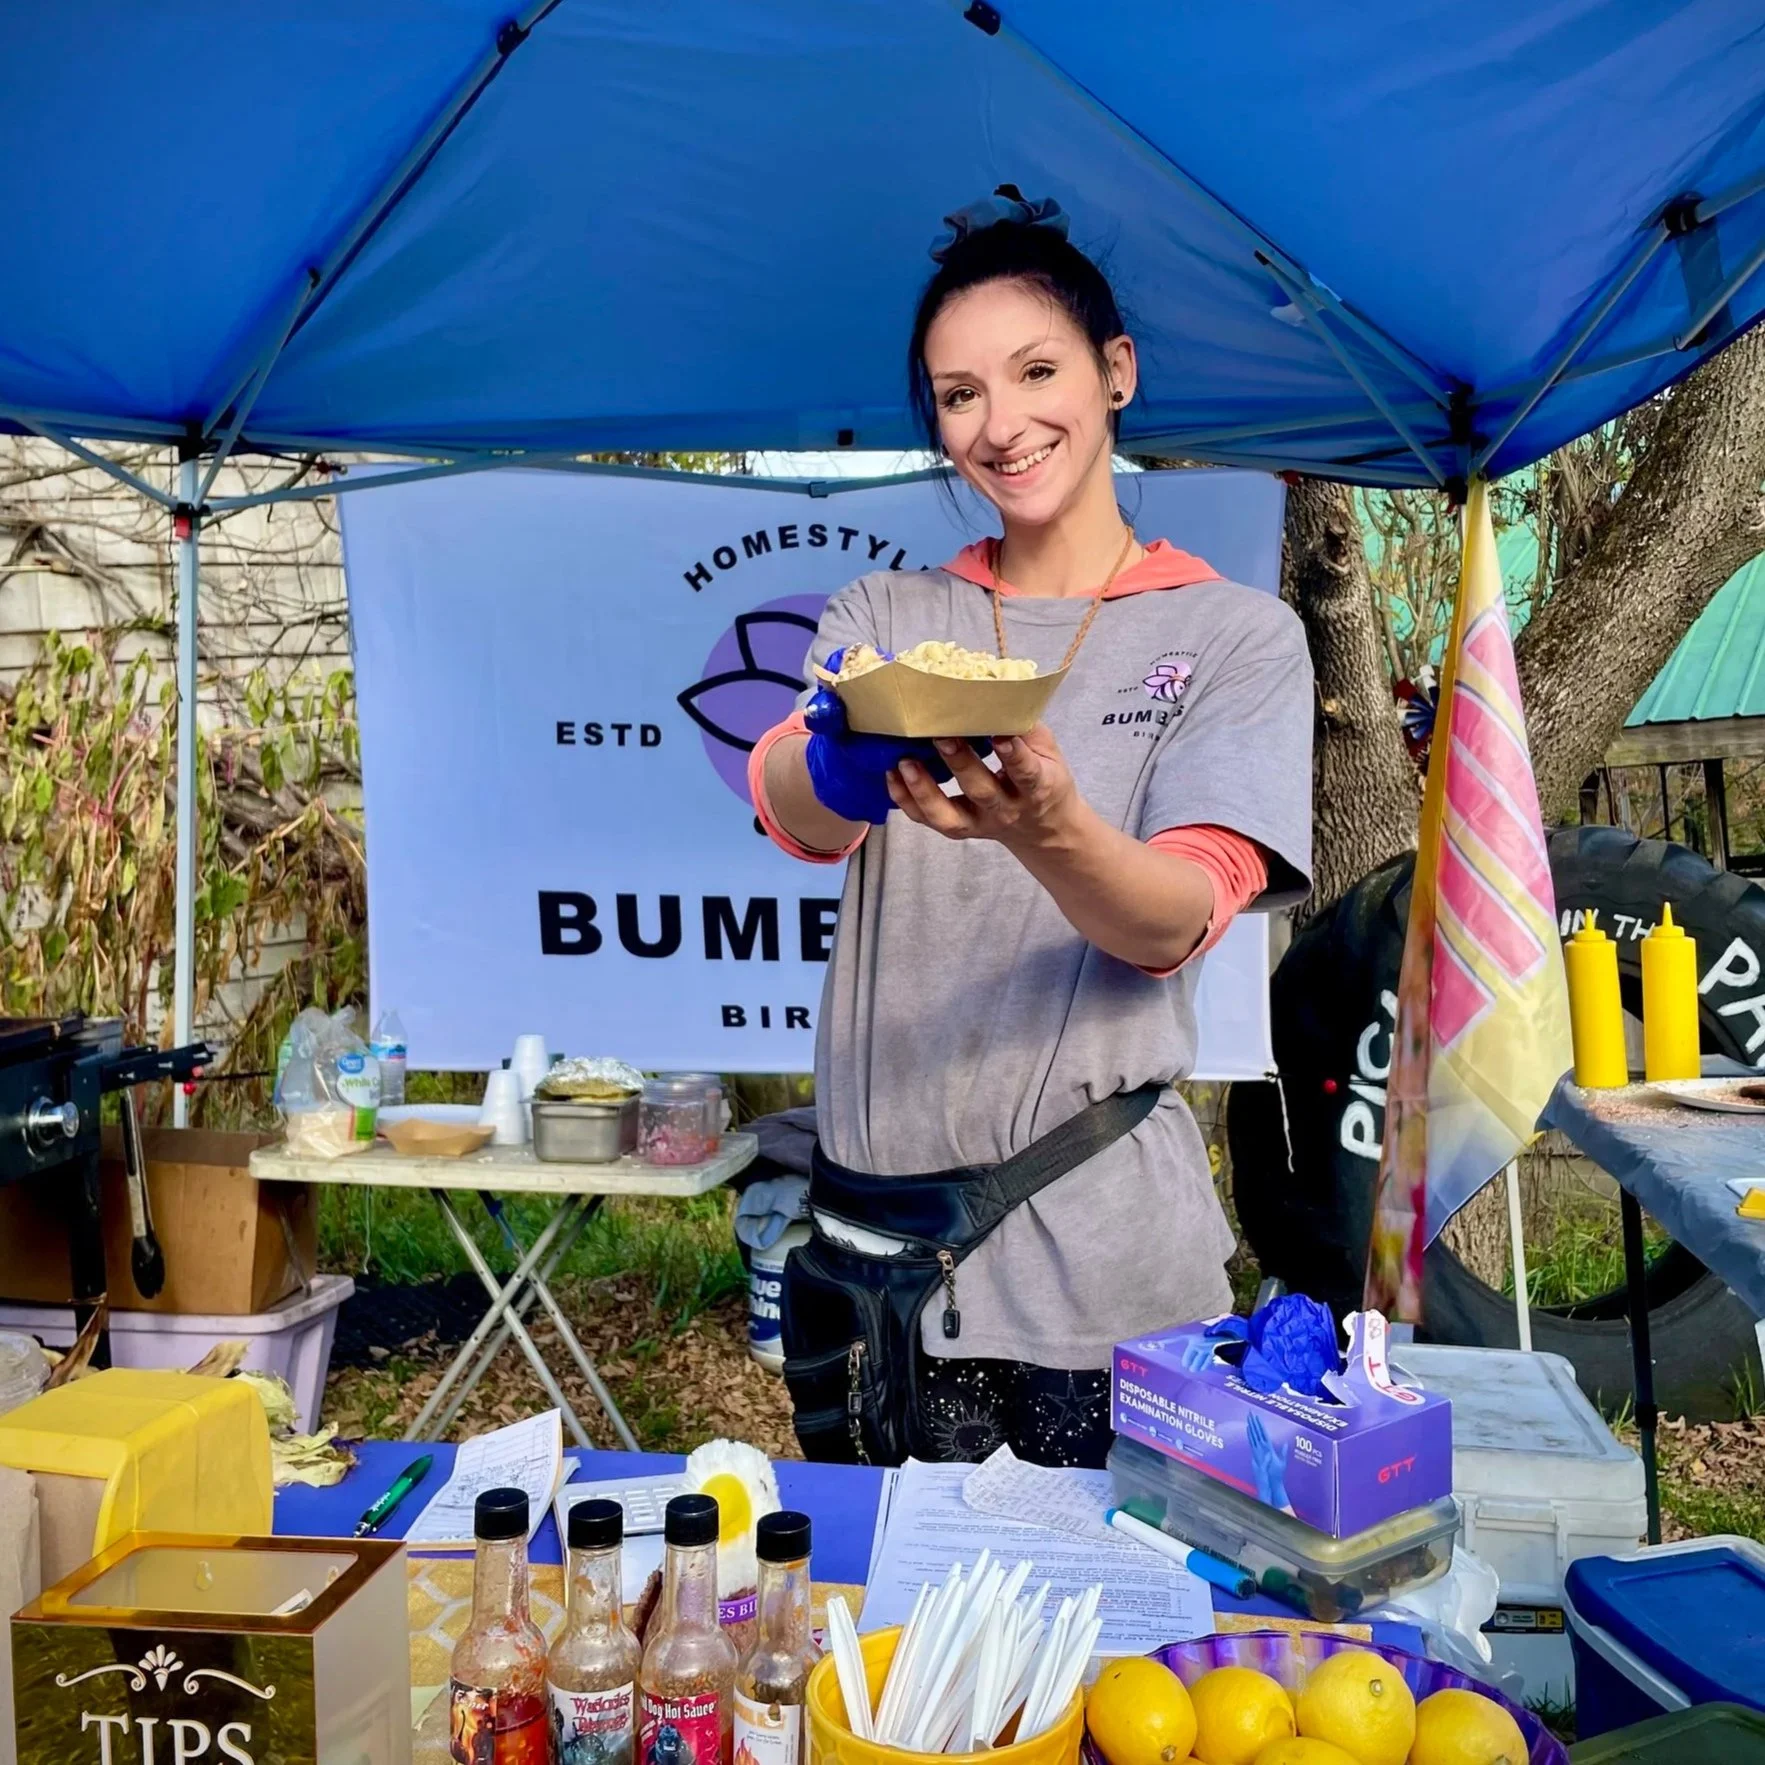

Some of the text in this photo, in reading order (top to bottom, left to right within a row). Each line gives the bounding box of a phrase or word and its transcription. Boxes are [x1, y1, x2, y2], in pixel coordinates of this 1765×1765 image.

[683, 523, 929, 592] HOMESTYL
[556, 721, 662, 747] ESTD
[1697, 937, 1765, 1067] PA
[1120, 1358, 1148, 1377] GTT
[1119, 1379, 1216, 1432] DISPOSABLE NITRILE
[1119, 1393, 1225, 1449] EXAMINATION GLOVES
[1223, 1380, 1338, 1431] DISPOSABLE NITRILE
[1268, 1392, 1350, 1428] EXAMINATION
[1295, 1435, 1312, 1453] 100
[1378, 1454, 1418, 1483] GTT
[684, 1702, 716, 1719] Sauce
[81, 1710, 255, 1765] TIPS
